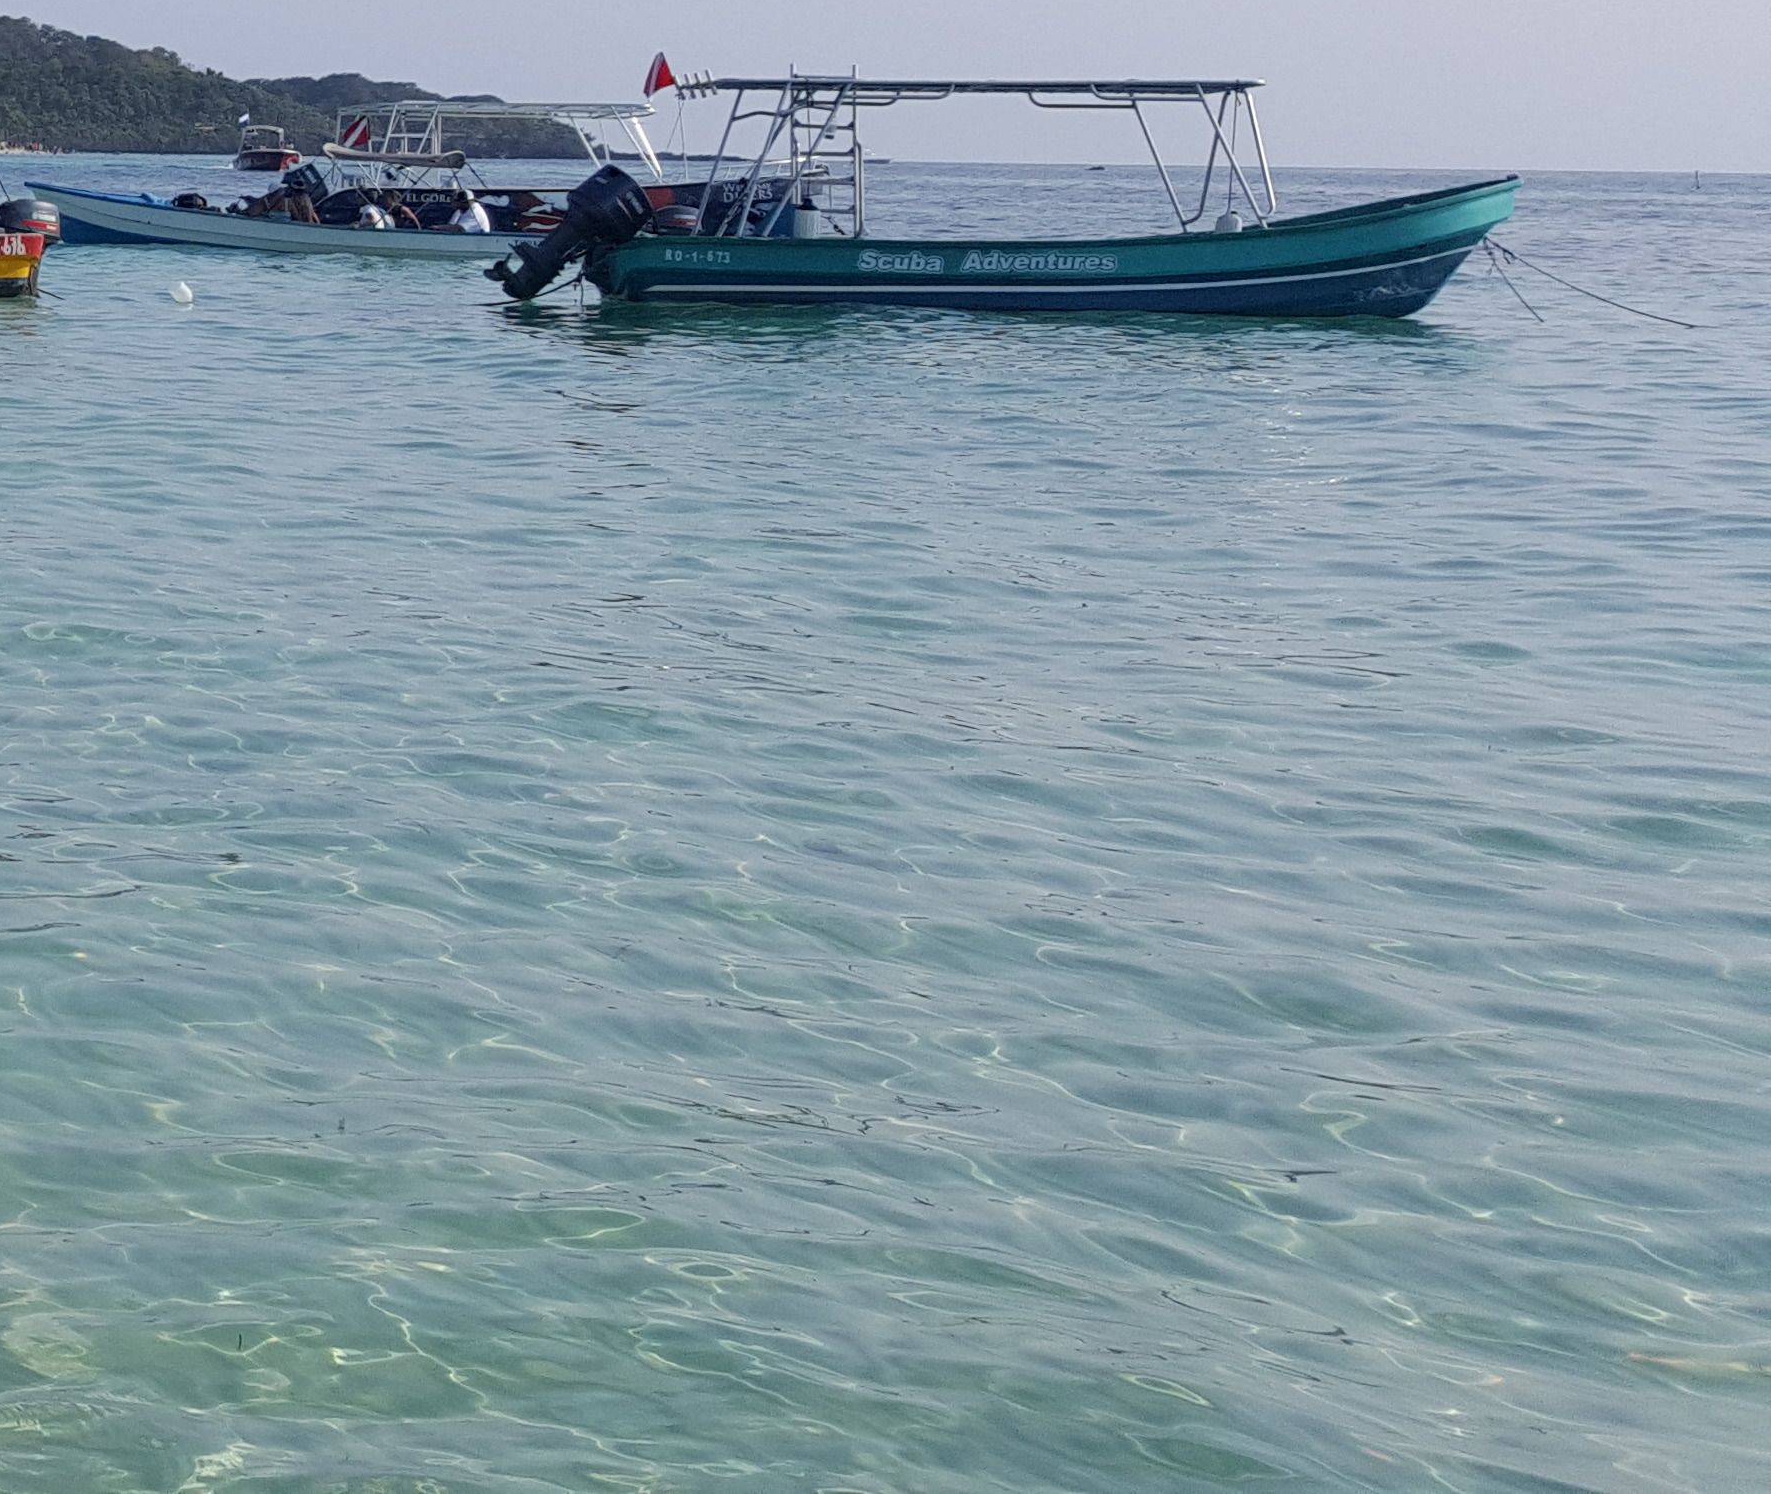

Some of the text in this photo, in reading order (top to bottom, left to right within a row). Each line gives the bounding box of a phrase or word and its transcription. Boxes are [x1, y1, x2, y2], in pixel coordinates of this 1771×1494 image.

[406, 194, 420, 203] EL
[858, 250, 1117, 274] Scuba Adventures
